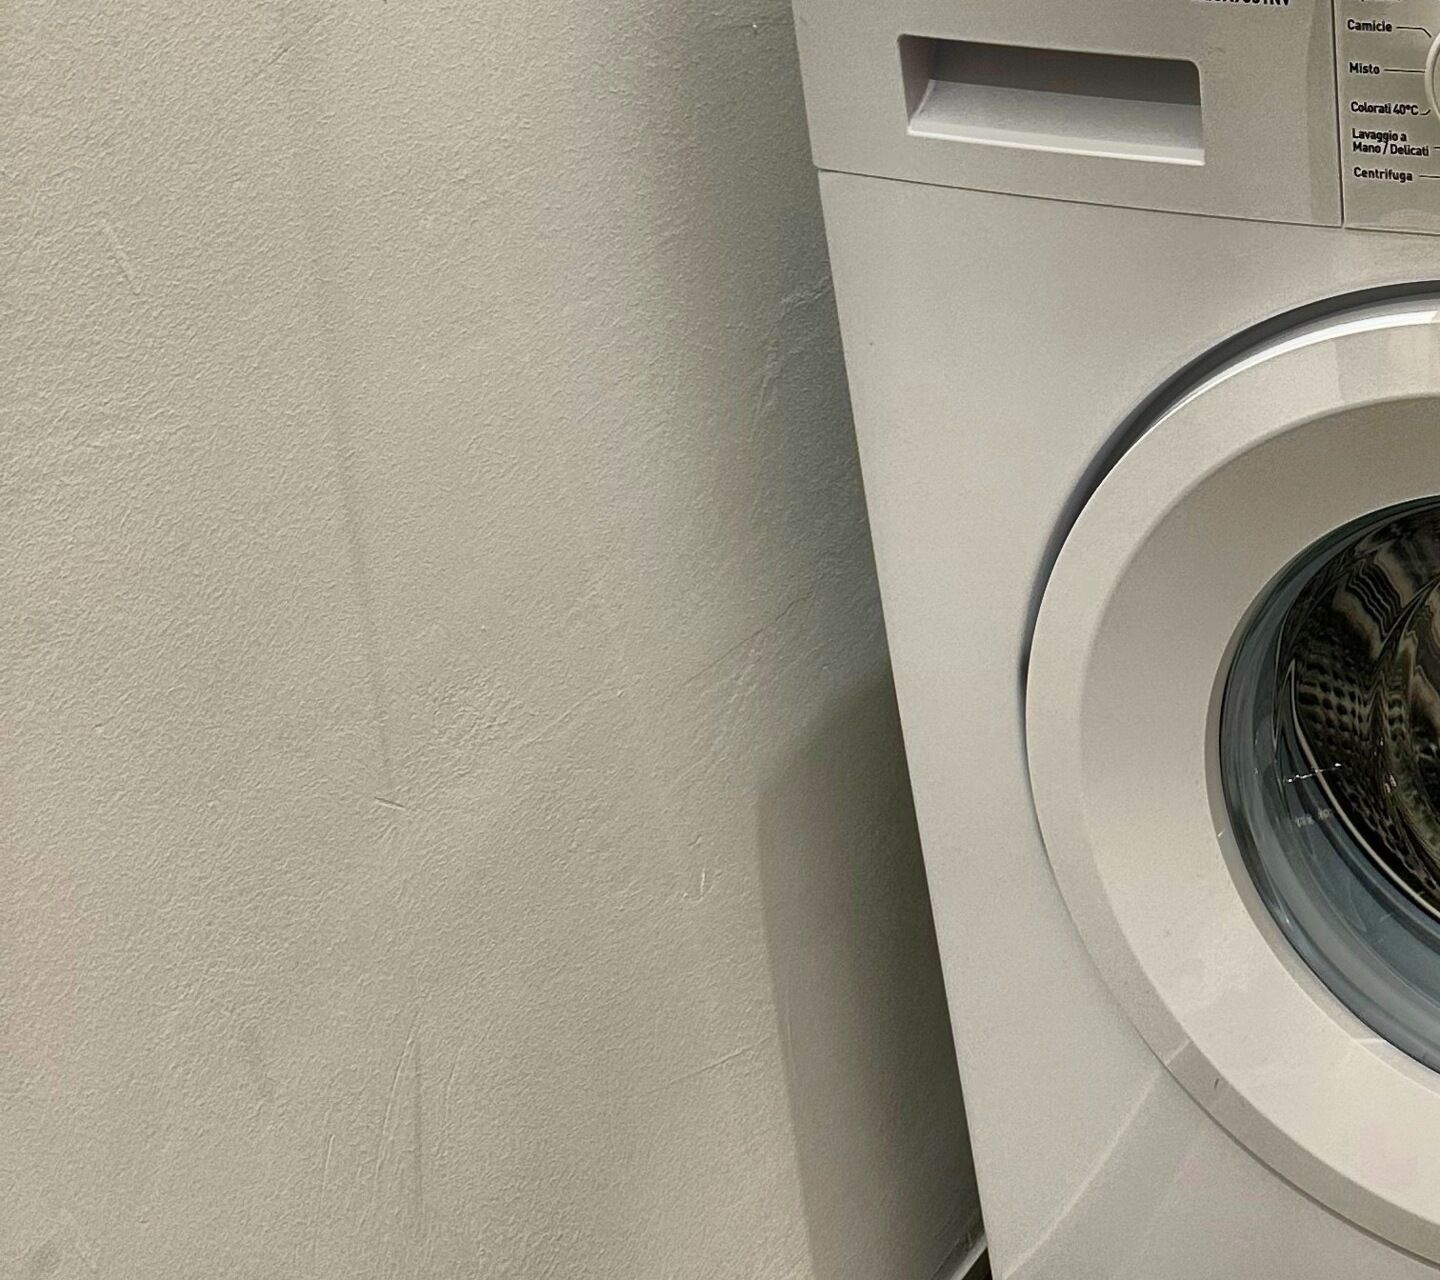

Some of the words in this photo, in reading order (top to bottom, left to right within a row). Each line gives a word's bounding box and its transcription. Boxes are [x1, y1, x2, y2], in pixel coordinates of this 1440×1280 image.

[1347, 20, 1393, 33] Camicie
[1349, 63, 1380, 75] Misto
[1350, 102, 1392, 115] Colorati
[1393, 103, 1419, 116] 40°C
[1352, 128, 1399, 144] Lavaggio
[1400, 133, 1408, 143] a
[1353, 142, 1382, 155] Mano
[1390, 144, 1430, 157] Delicati
[1353, 167, 1413, 183] Centrifuga
